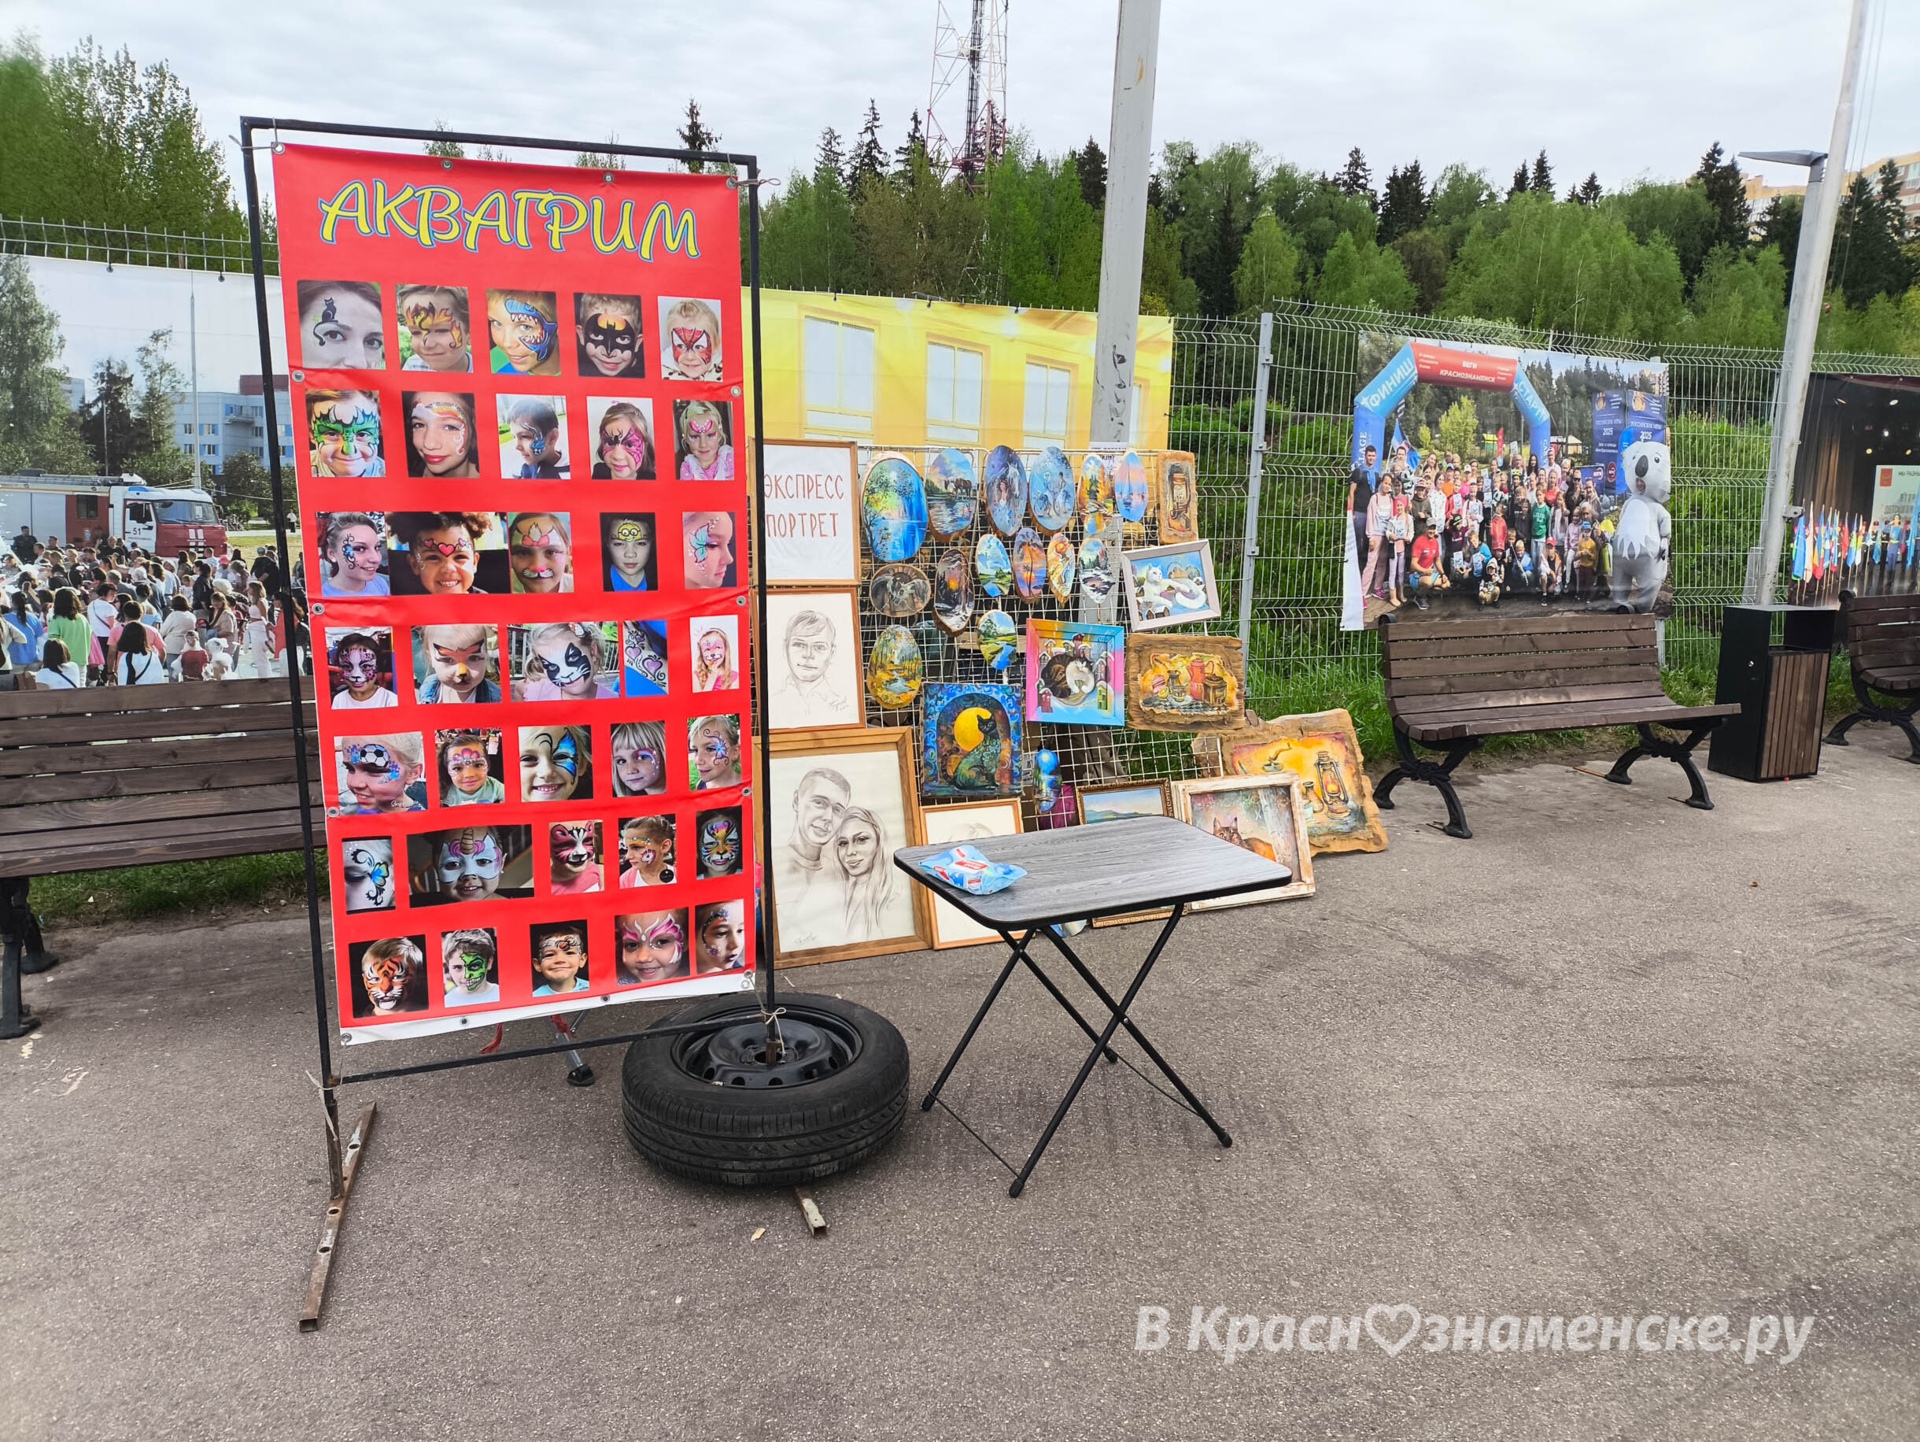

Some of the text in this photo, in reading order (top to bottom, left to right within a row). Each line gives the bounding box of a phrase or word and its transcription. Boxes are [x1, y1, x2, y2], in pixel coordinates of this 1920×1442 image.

[318, 178, 702, 262] АКВАГРИМ
[1368, 357, 1415, 407] ФИНИШ
[764, 474, 844, 499] ЭКСПРЕСС
[766, 512, 839, 538] ПОРТРЕТ
